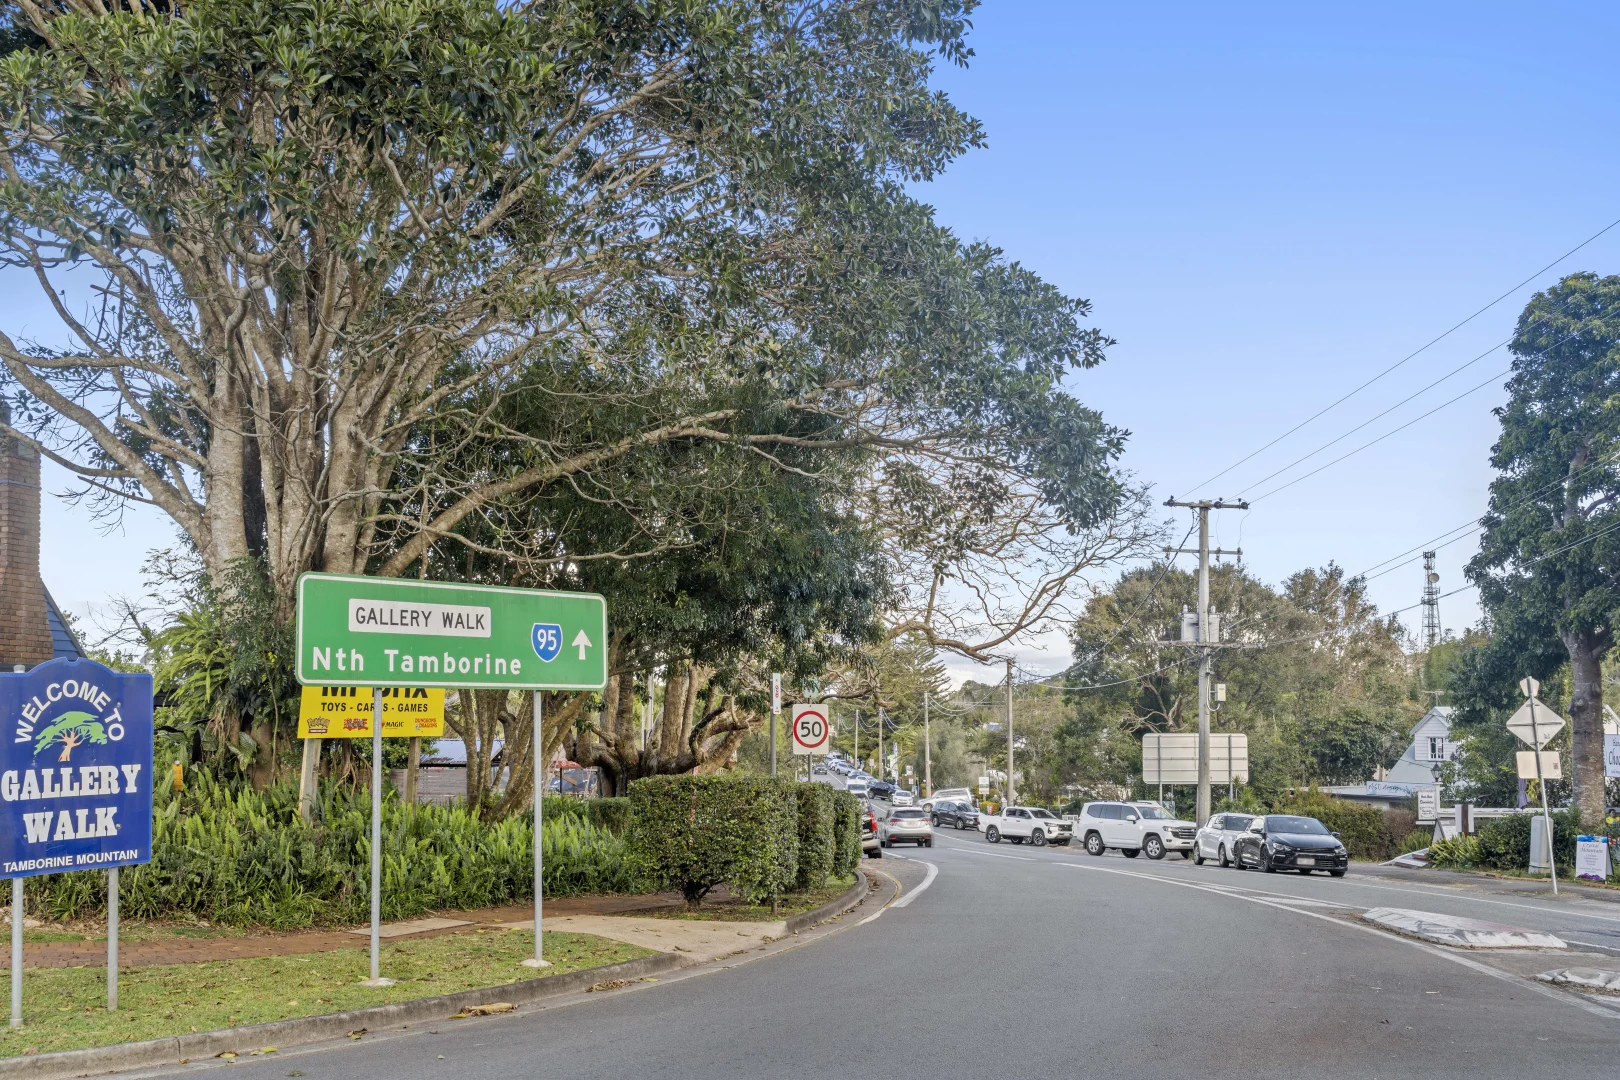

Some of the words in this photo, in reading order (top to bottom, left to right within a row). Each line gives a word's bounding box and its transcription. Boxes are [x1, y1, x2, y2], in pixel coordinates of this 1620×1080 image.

[355, 606, 432, 628] GALLERY
[442, 611, 485, 631] WALK
[536, 629, 558, 651] 95
[312, 646, 364, 671] Nth
[384, 649, 522, 675] Tamborine
[14, 679, 111, 744] WELCOME
[104, 708, 125, 742] TO
[321, 702, 347, 712] TOYS
[356, 702, 389, 712] CARS
[397, 703, 429, 713] GAMES
[800, 721, 822, 738] 50
[1, 763, 142, 802] GALLERY
[23, 806, 118, 843] WALK
[3, 855, 73, 873] TAMBORINE
[76, 849, 138, 865] MOUNTAIN
